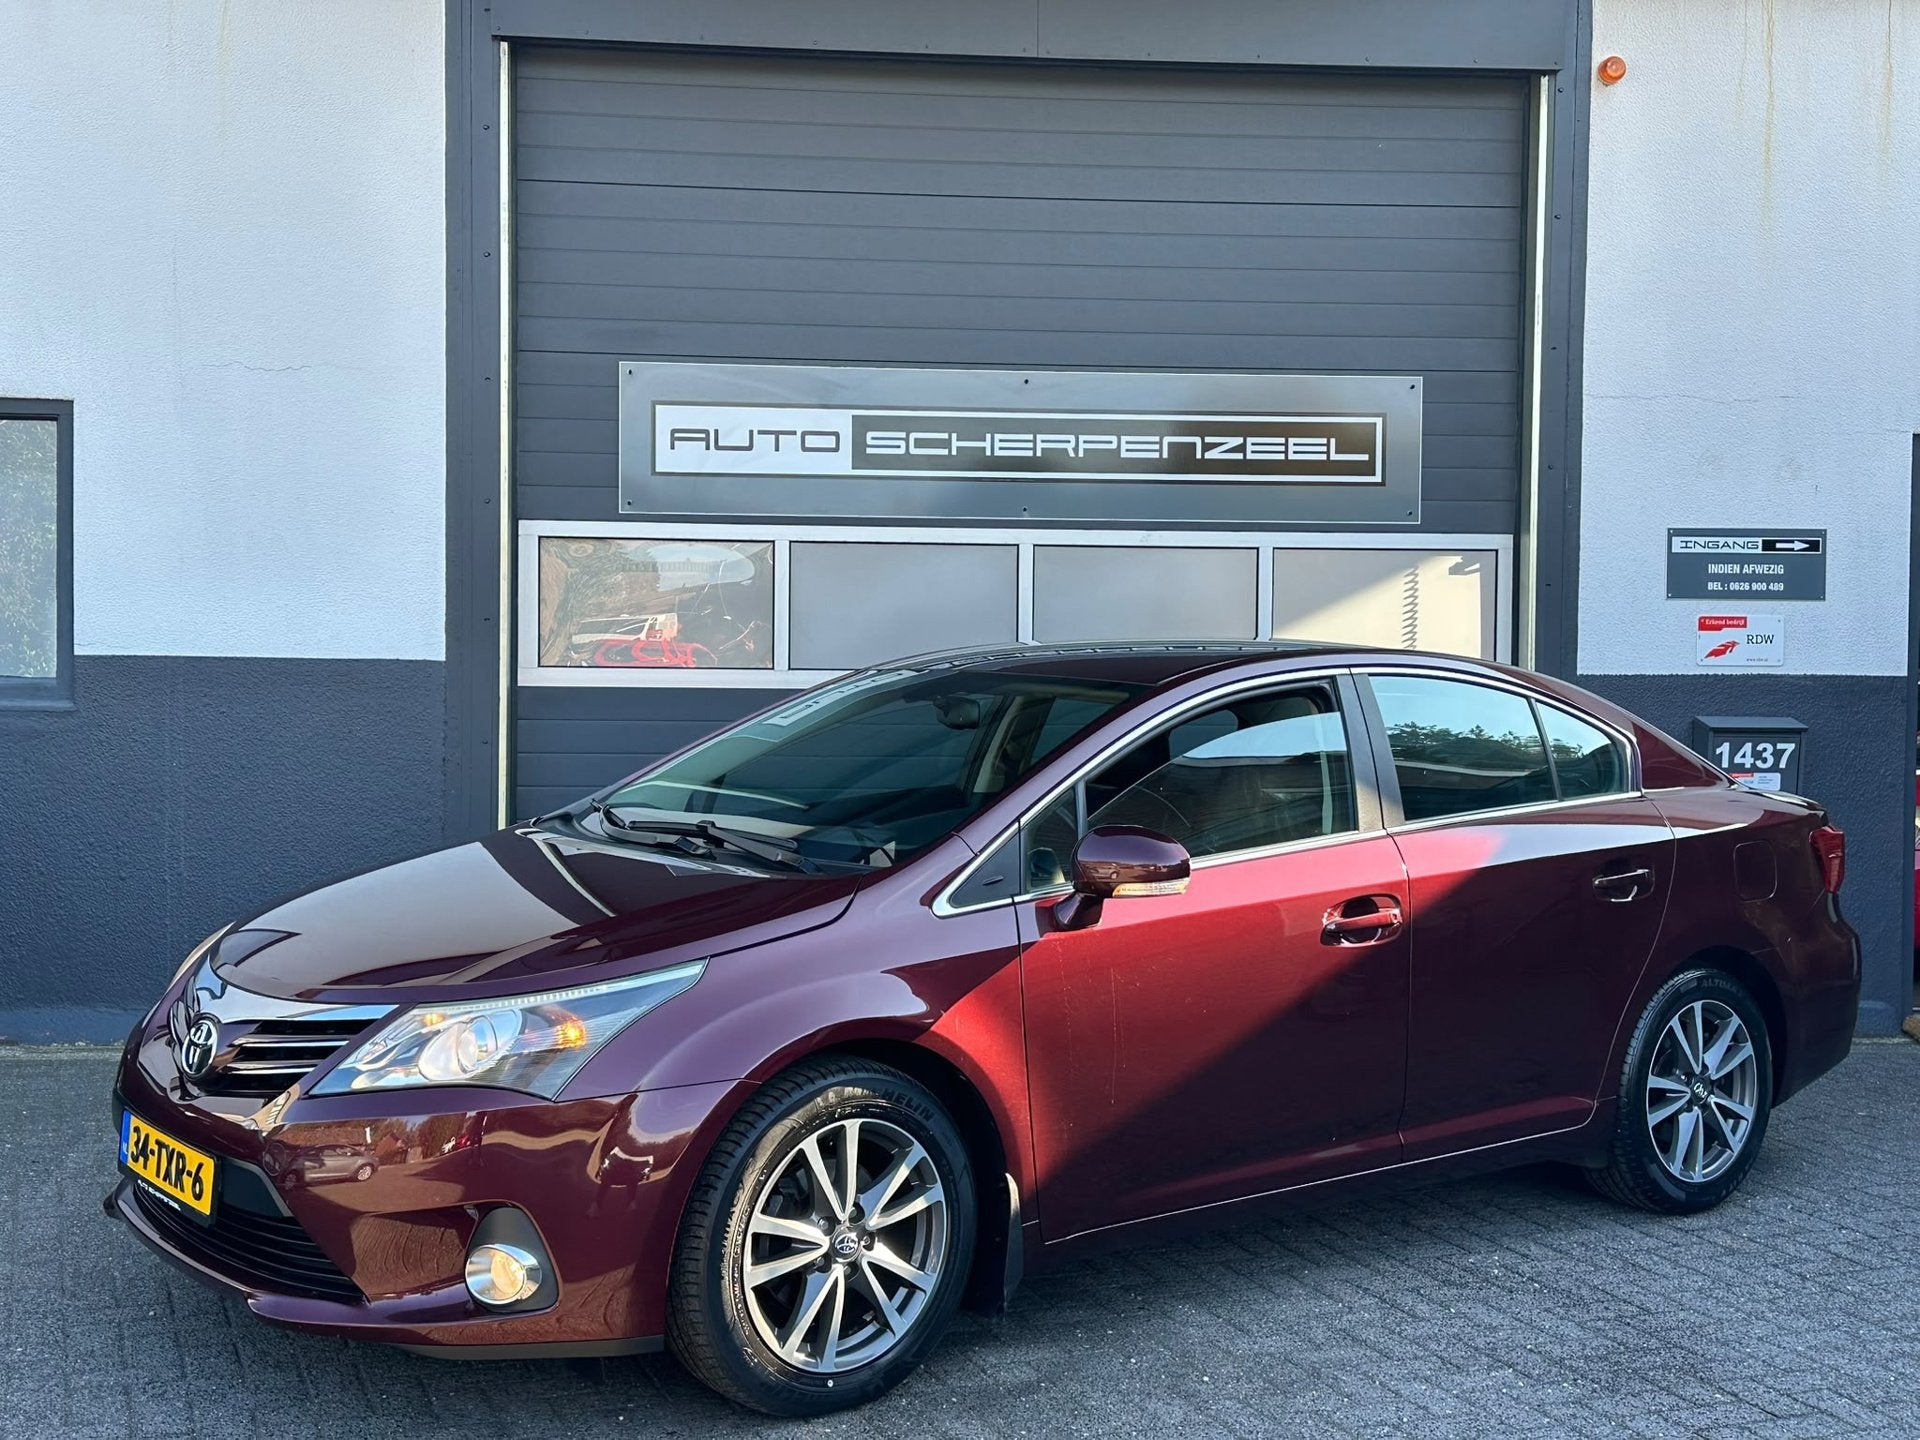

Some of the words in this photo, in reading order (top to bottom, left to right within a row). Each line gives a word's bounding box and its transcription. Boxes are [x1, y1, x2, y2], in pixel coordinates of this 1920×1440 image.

[668, 426, 841, 453] AUTO
[865, 430, 1370, 462] SCHERPENZEEL
[1680, 540, 1759, 549] INGANG
[1708, 563, 1740, 574] INDIEN
[1742, 564, 1784, 574] AFWEZIG
[1729, 582, 1750, 591] 0626
[1751, 582, 1767, 591] 900
[1768, 582, 1784, 591] 489
[1746, 634, 1774, 644] RDW
[1715, 741, 1796, 769] 1437
[130, 1124, 205, 1202] 34-TXR-6
